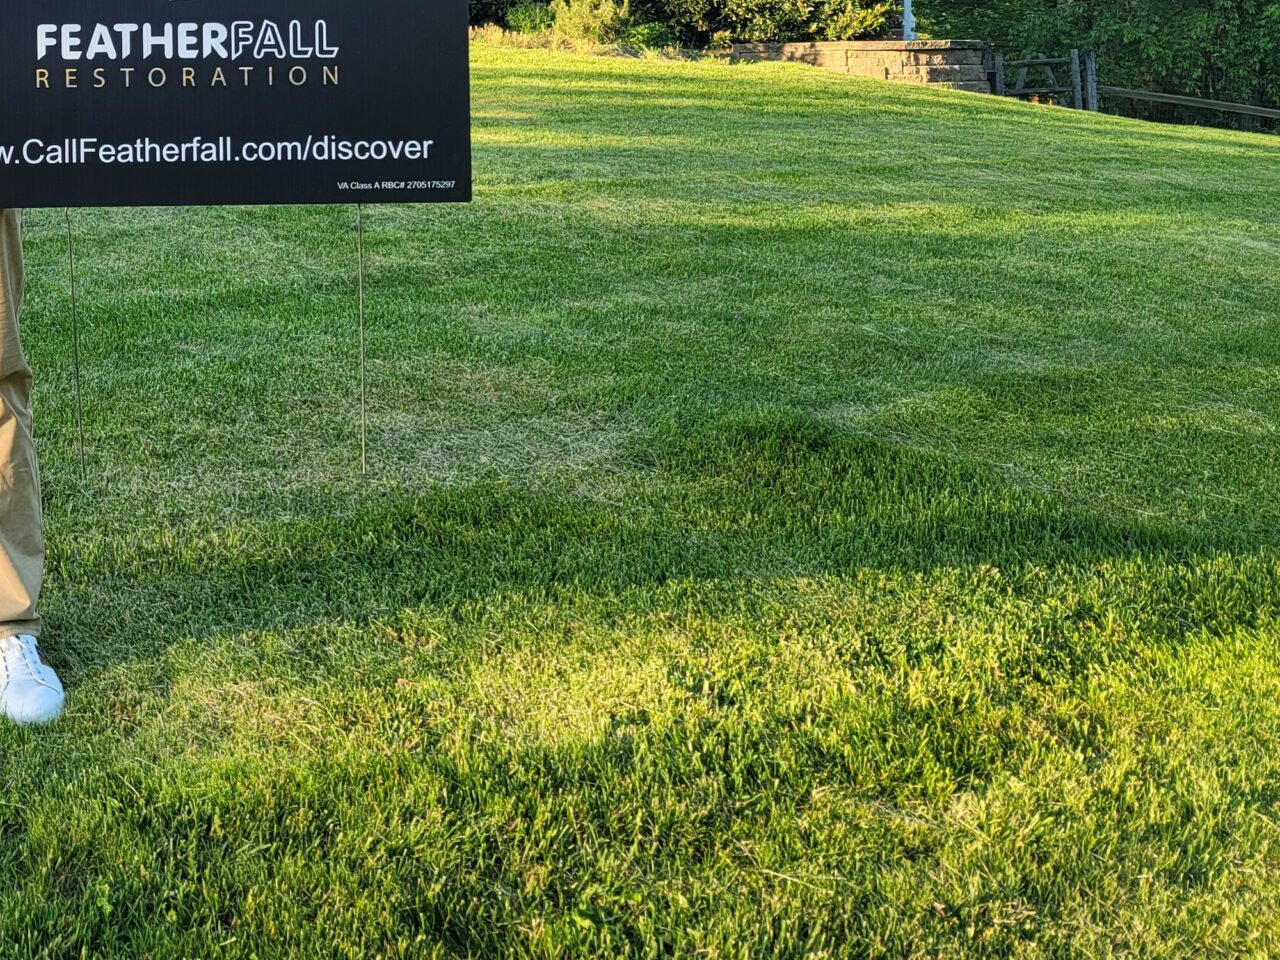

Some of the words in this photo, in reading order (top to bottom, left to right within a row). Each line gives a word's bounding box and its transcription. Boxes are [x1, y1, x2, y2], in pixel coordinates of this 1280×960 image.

[36, 19, 340, 61] FEATHERFALL
[36, 65, 340, 89] RESTORATION
[337, 181, 350, 190] VA
[350, 181, 373, 190] Class
[373, 181, 381, 189] A
[381, 180, 405, 189] RBC#
[406, 180, 456, 189] 2705175297
